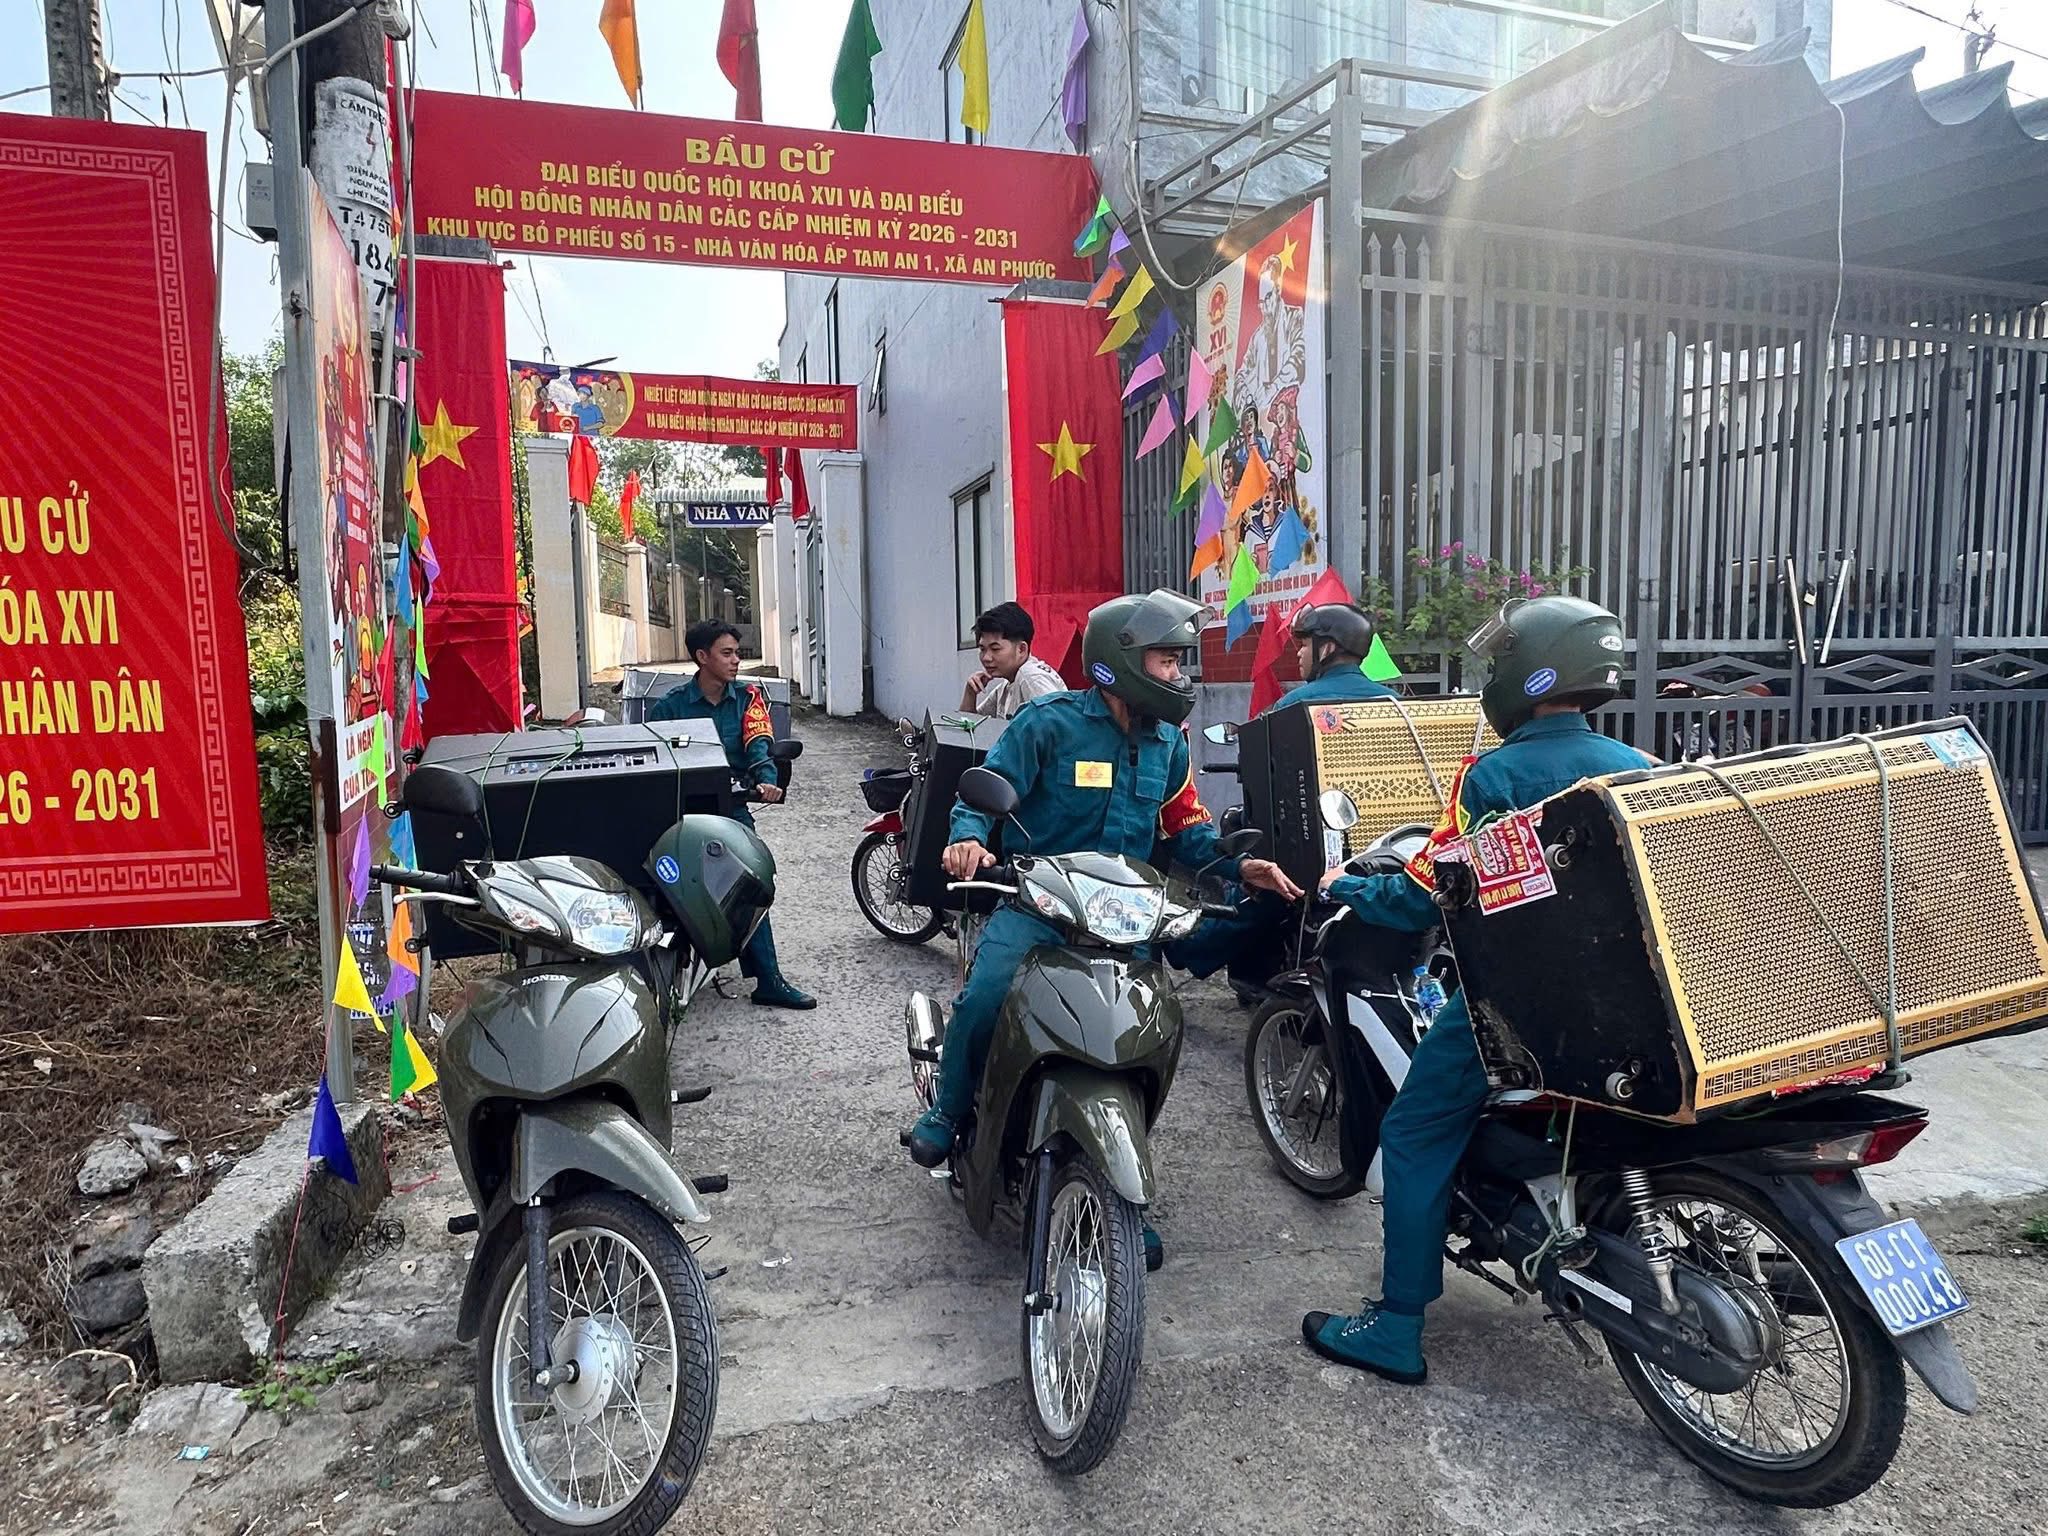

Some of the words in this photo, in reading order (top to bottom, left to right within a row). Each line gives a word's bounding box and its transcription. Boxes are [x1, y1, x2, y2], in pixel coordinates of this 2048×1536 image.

[686, 134, 766, 169] BẦU
[780, 142, 835, 175] CỬ
[541, 161, 578, 187] ĐẠI
[586, 160, 636, 189] BIỂU
[643, 168, 701, 195] QUỐC
[707, 174, 743, 202] HỘI
[749, 180, 804, 204] KHOÁ
[811, 185, 843, 207] XVI
[849, 186, 875, 209] VÀ
[880, 191, 913, 215] ĐẠI
[920, 190, 964, 216] BIỂU
[475, 184, 513, 213] HỘI
[520, 186, 583, 215] ĐỒNG
[590, 195, 652, 221] NHÂN
[659, 200, 703, 225] DÂN
[710, 204, 751, 229] CÁC
[758, 206, 799, 231] CẤP
[806, 213, 871, 240] NHIỆM
[878, 217, 903, 240] KỲ
[909, 223, 956, 244] 2026
[974, 227, 1018, 249] 2031
[427, 217, 470, 237] KHU
[476, 220, 516, 244] VỰC
[522, 219, 549, 244] BỎ
[556, 224, 614, 249] PHIẾU
[620, 227, 646, 251] SỐ
[652, 235, 676, 253] 15
[694, 236, 734, 258] NHÀ
[739, 238, 776, 260] VĂN
[782, 241, 819, 263] HÓA
[824, 241, 848, 265] ẤP
[853, 249, 889, 268] TAM
[894, 253, 919, 271] AN
[924, 254, 940, 274] 1,
[944, 253, 967, 274] XÃ
[972, 258, 996, 276] AN
[1001, 258, 1057, 280] PHƯỚC
[373, 279, 387, 306] 7
[1210, 326, 1227, 353] XVI
[39, 480, 90, 555] CỬ
[693, 503, 730, 520] NHÀ
[735, 503, 770, 520] VĂN
[57, 590, 119, 645] XVI
[0, 666, 80, 735] HÂN
[90, 666, 165, 733] DÂN
[44, 796, 61, 809] -
[71, 767, 160, 821] 2031
[522, 974, 570, 986] HONDA
[1854, 1228, 1927, 1280] 60-C1
[1873, 1266, 1962, 1327] 000.48
